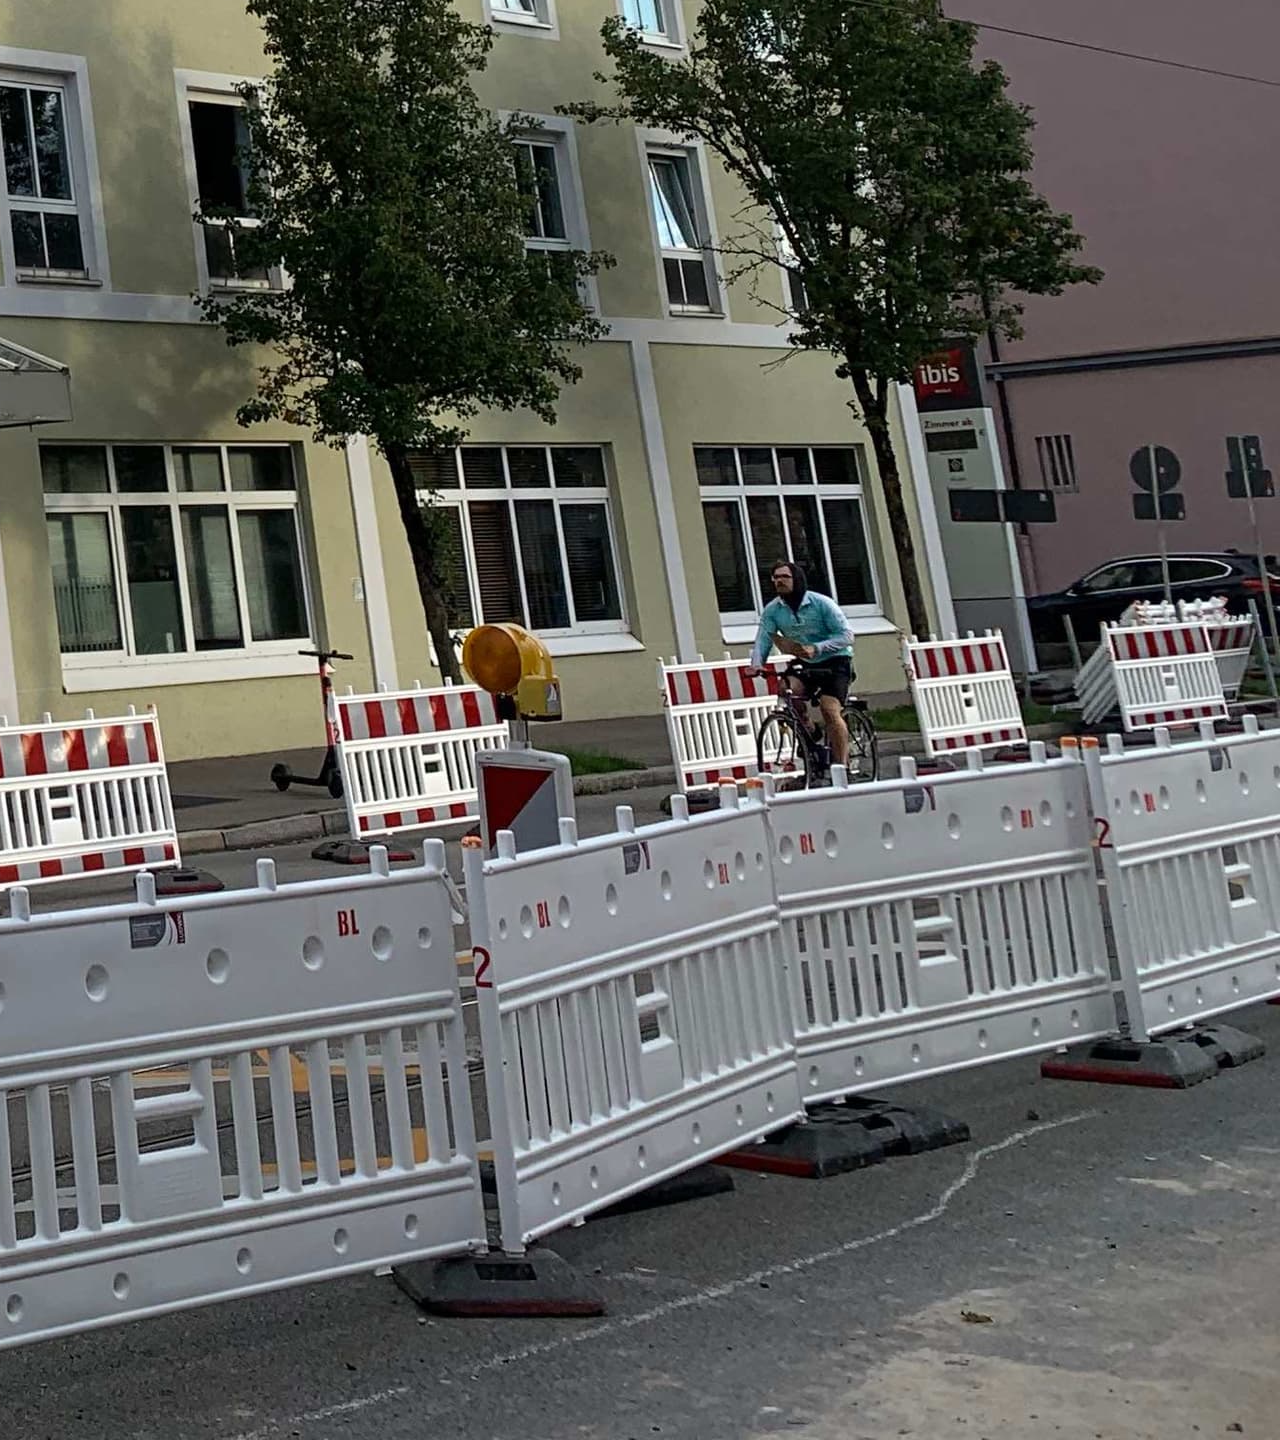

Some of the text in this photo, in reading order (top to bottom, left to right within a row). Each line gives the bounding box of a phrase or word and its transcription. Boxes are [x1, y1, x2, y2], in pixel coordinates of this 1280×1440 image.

[920, 364, 960, 385] ibis
[924, 421, 959, 429] Zimmer
[800, 833, 815, 854] BL
[1094, 818, 1113, 848] 2
[718, 864, 730, 884] BL
[338, 910, 359, 936] BL
[537, 901, 551, 928] BL
[472, 946, 493, 988] 2
